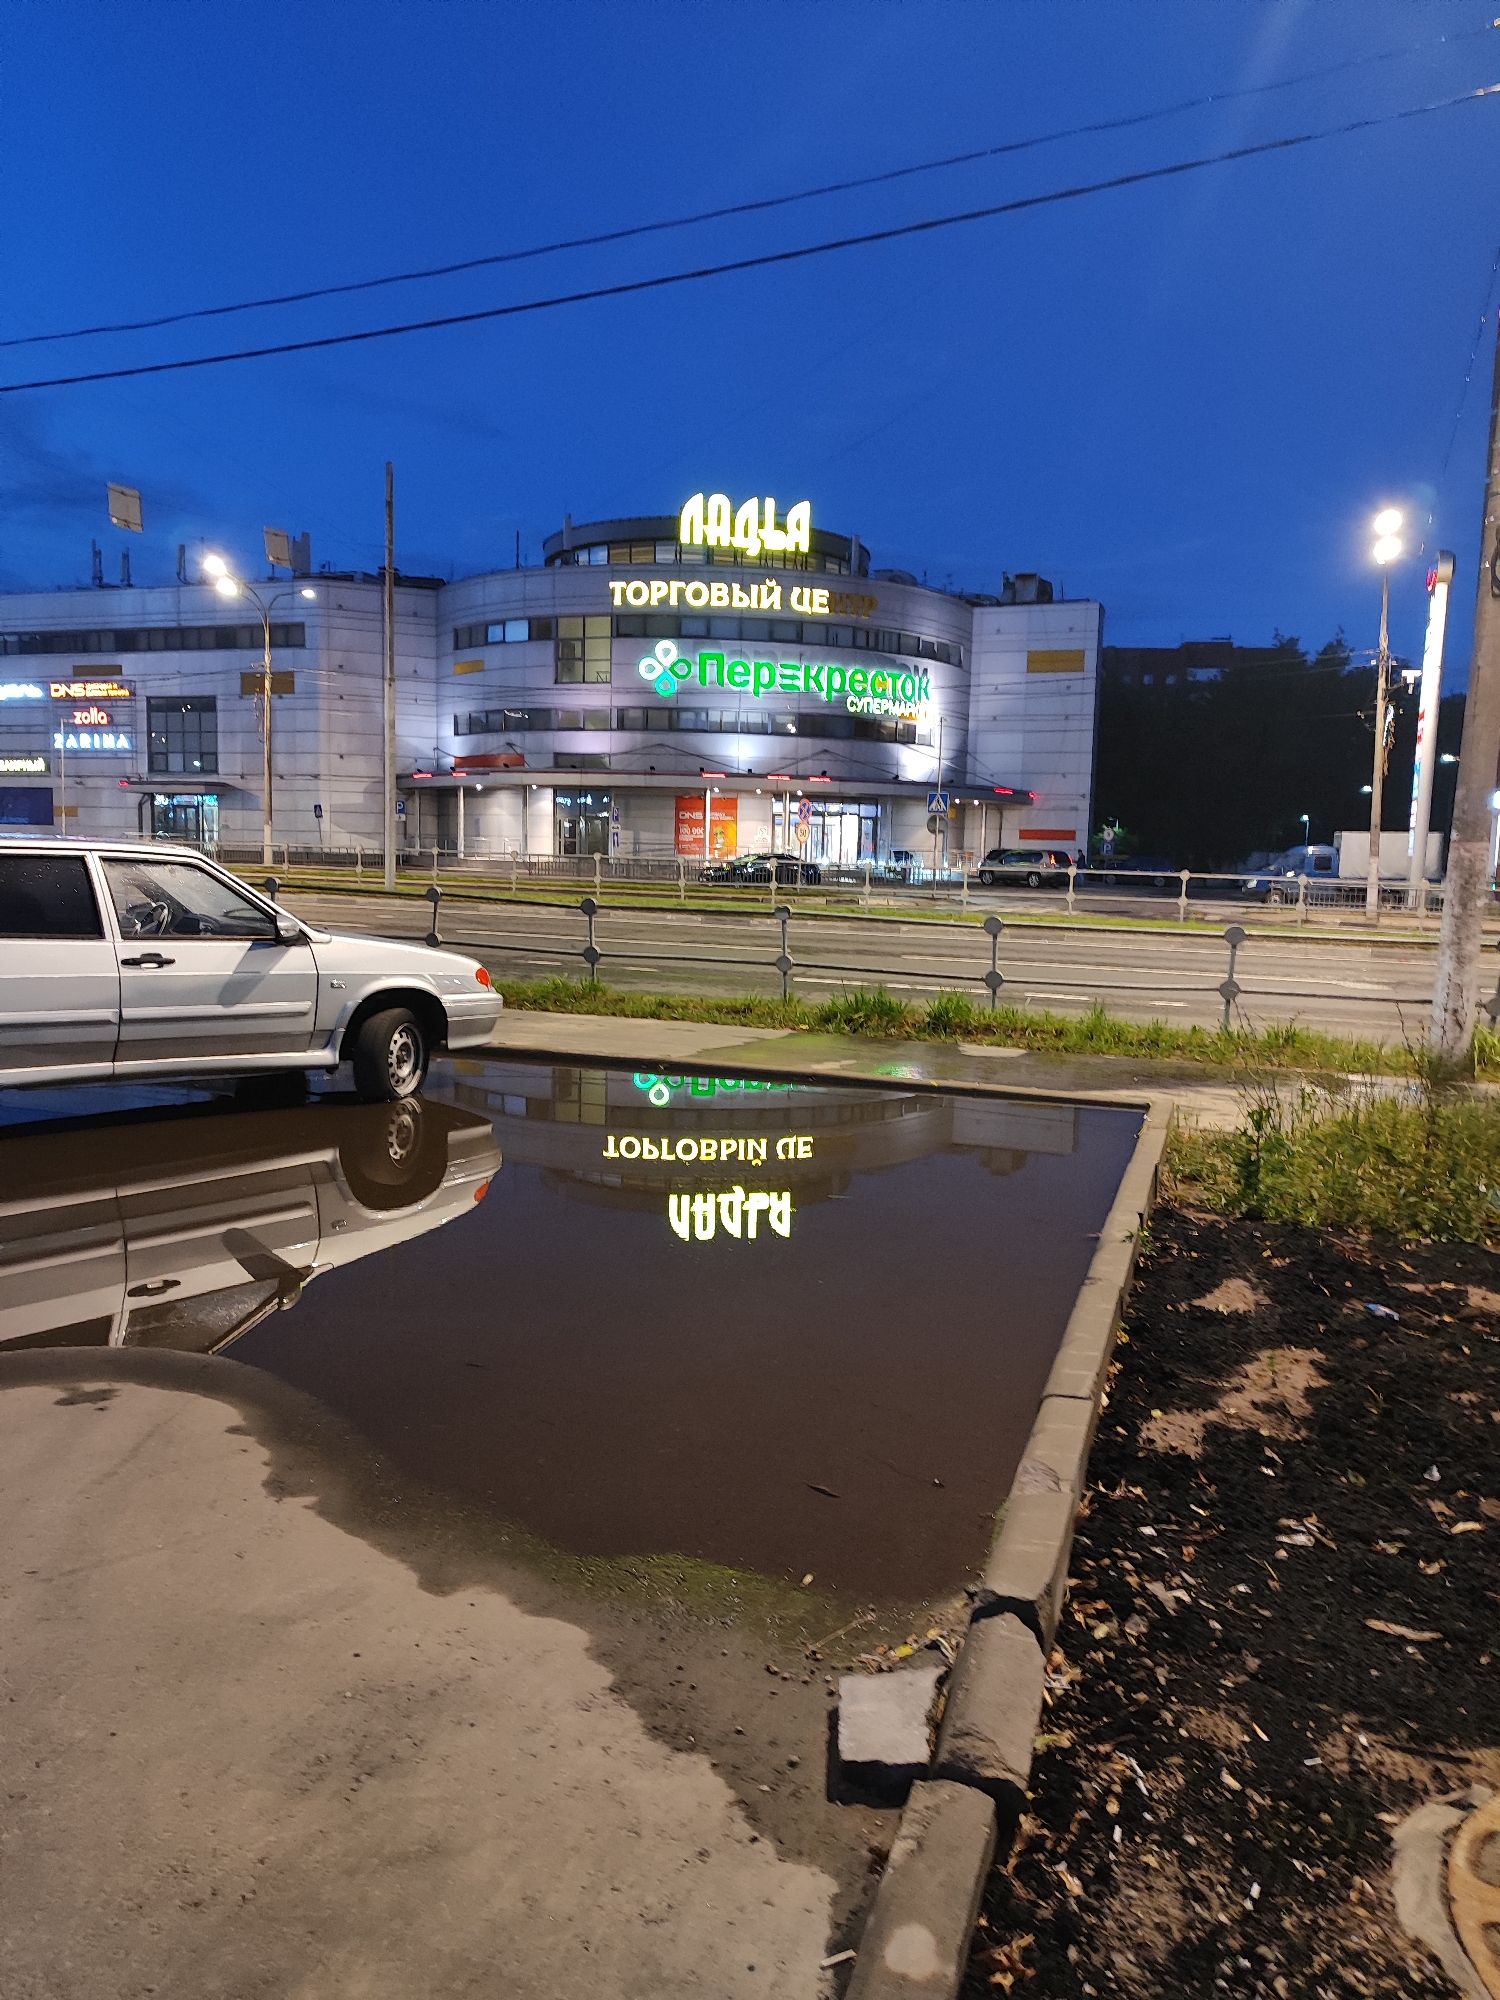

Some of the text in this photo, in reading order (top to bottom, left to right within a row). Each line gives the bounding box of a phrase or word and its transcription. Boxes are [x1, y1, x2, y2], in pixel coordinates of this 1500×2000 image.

[679, 492, 811, 556] ЛАДЬЯ
[609, 577, 782, 611] ТОРГОВЫЙ
[50, 683, 86, 698] DNS
[73, 706, 109, 725] zolla
[54, 733, 130, 749] ZARINA
[396, 801, 404, 814] P
